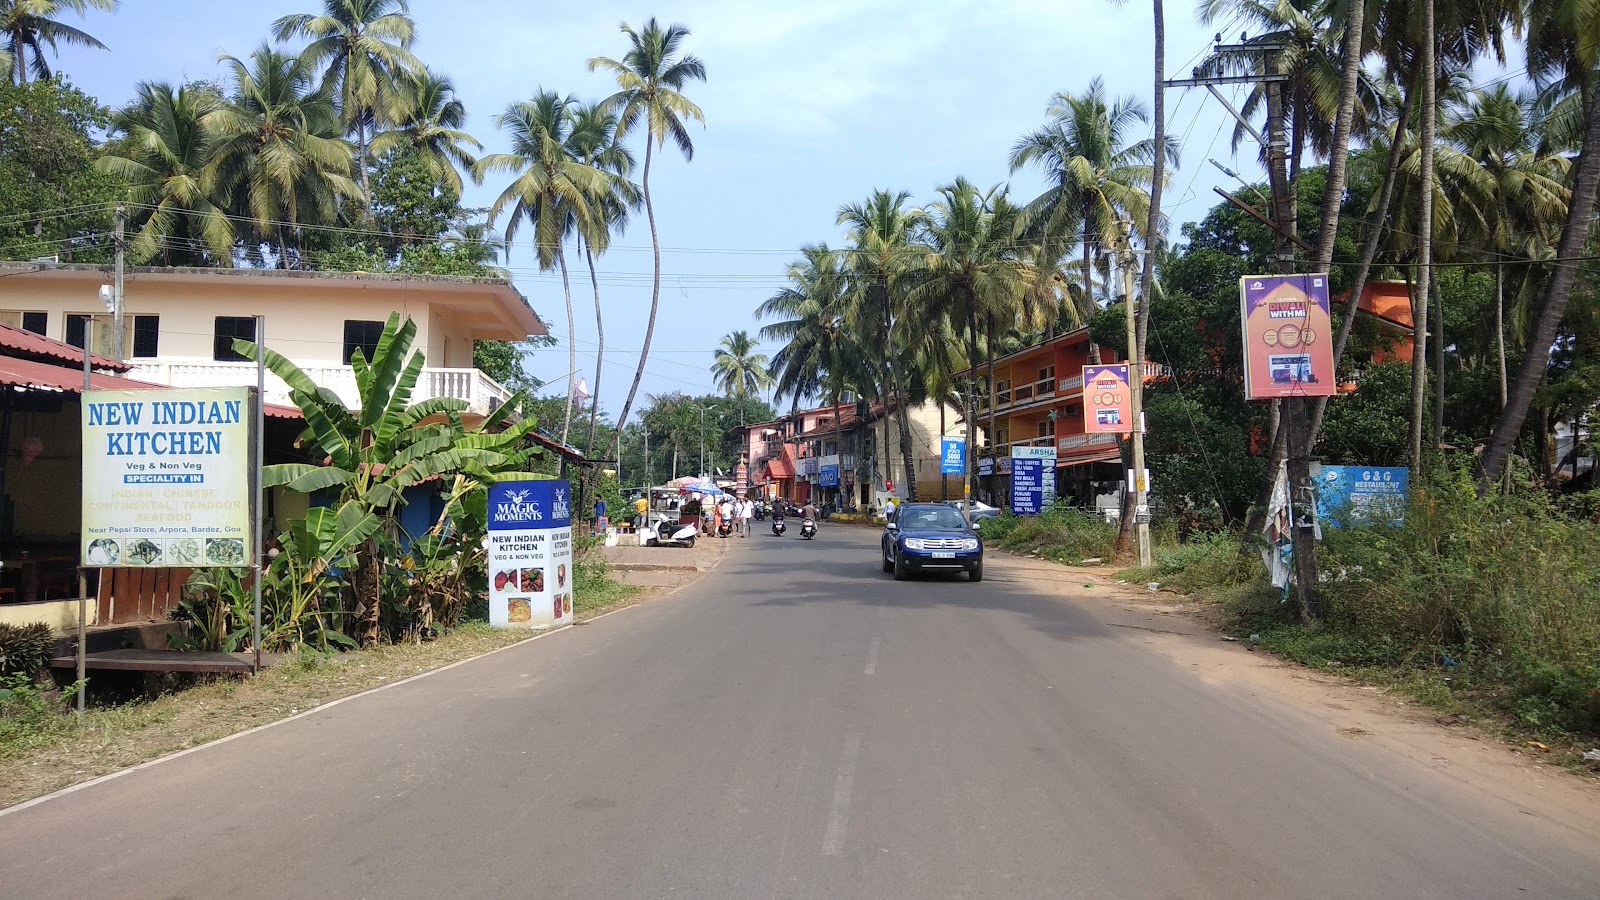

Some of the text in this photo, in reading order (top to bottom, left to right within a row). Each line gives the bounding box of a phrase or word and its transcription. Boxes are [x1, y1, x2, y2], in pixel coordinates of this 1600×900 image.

[1270, 302, 1305, 310] DIWALI
[88, 401, 241, 426] NEW INDIAN
[107, 432, 222, 455] KITCHEN
[126, 462, 145, 471] Veg
[183, 462, 202, 470] Veg
[1363, 471, 1371, 481] G
[1373, 471, 1381, 481] &
[112, 489, 153, 498] INDIAN
[163, 489, 216, 498] CHINESE
[88, 501, 172, 510] CONTINENTAL
[183, 500, 241, 509] TANDOOR
[497, 503, 539, 513] MAGIC
[553, 501, 567, 512] MAGIC
[136, 513, 192, 522] SEAFOOD
[494, 512, 542, 521] MOMENTS
[552, 510, 569, 519] MOMENTS
